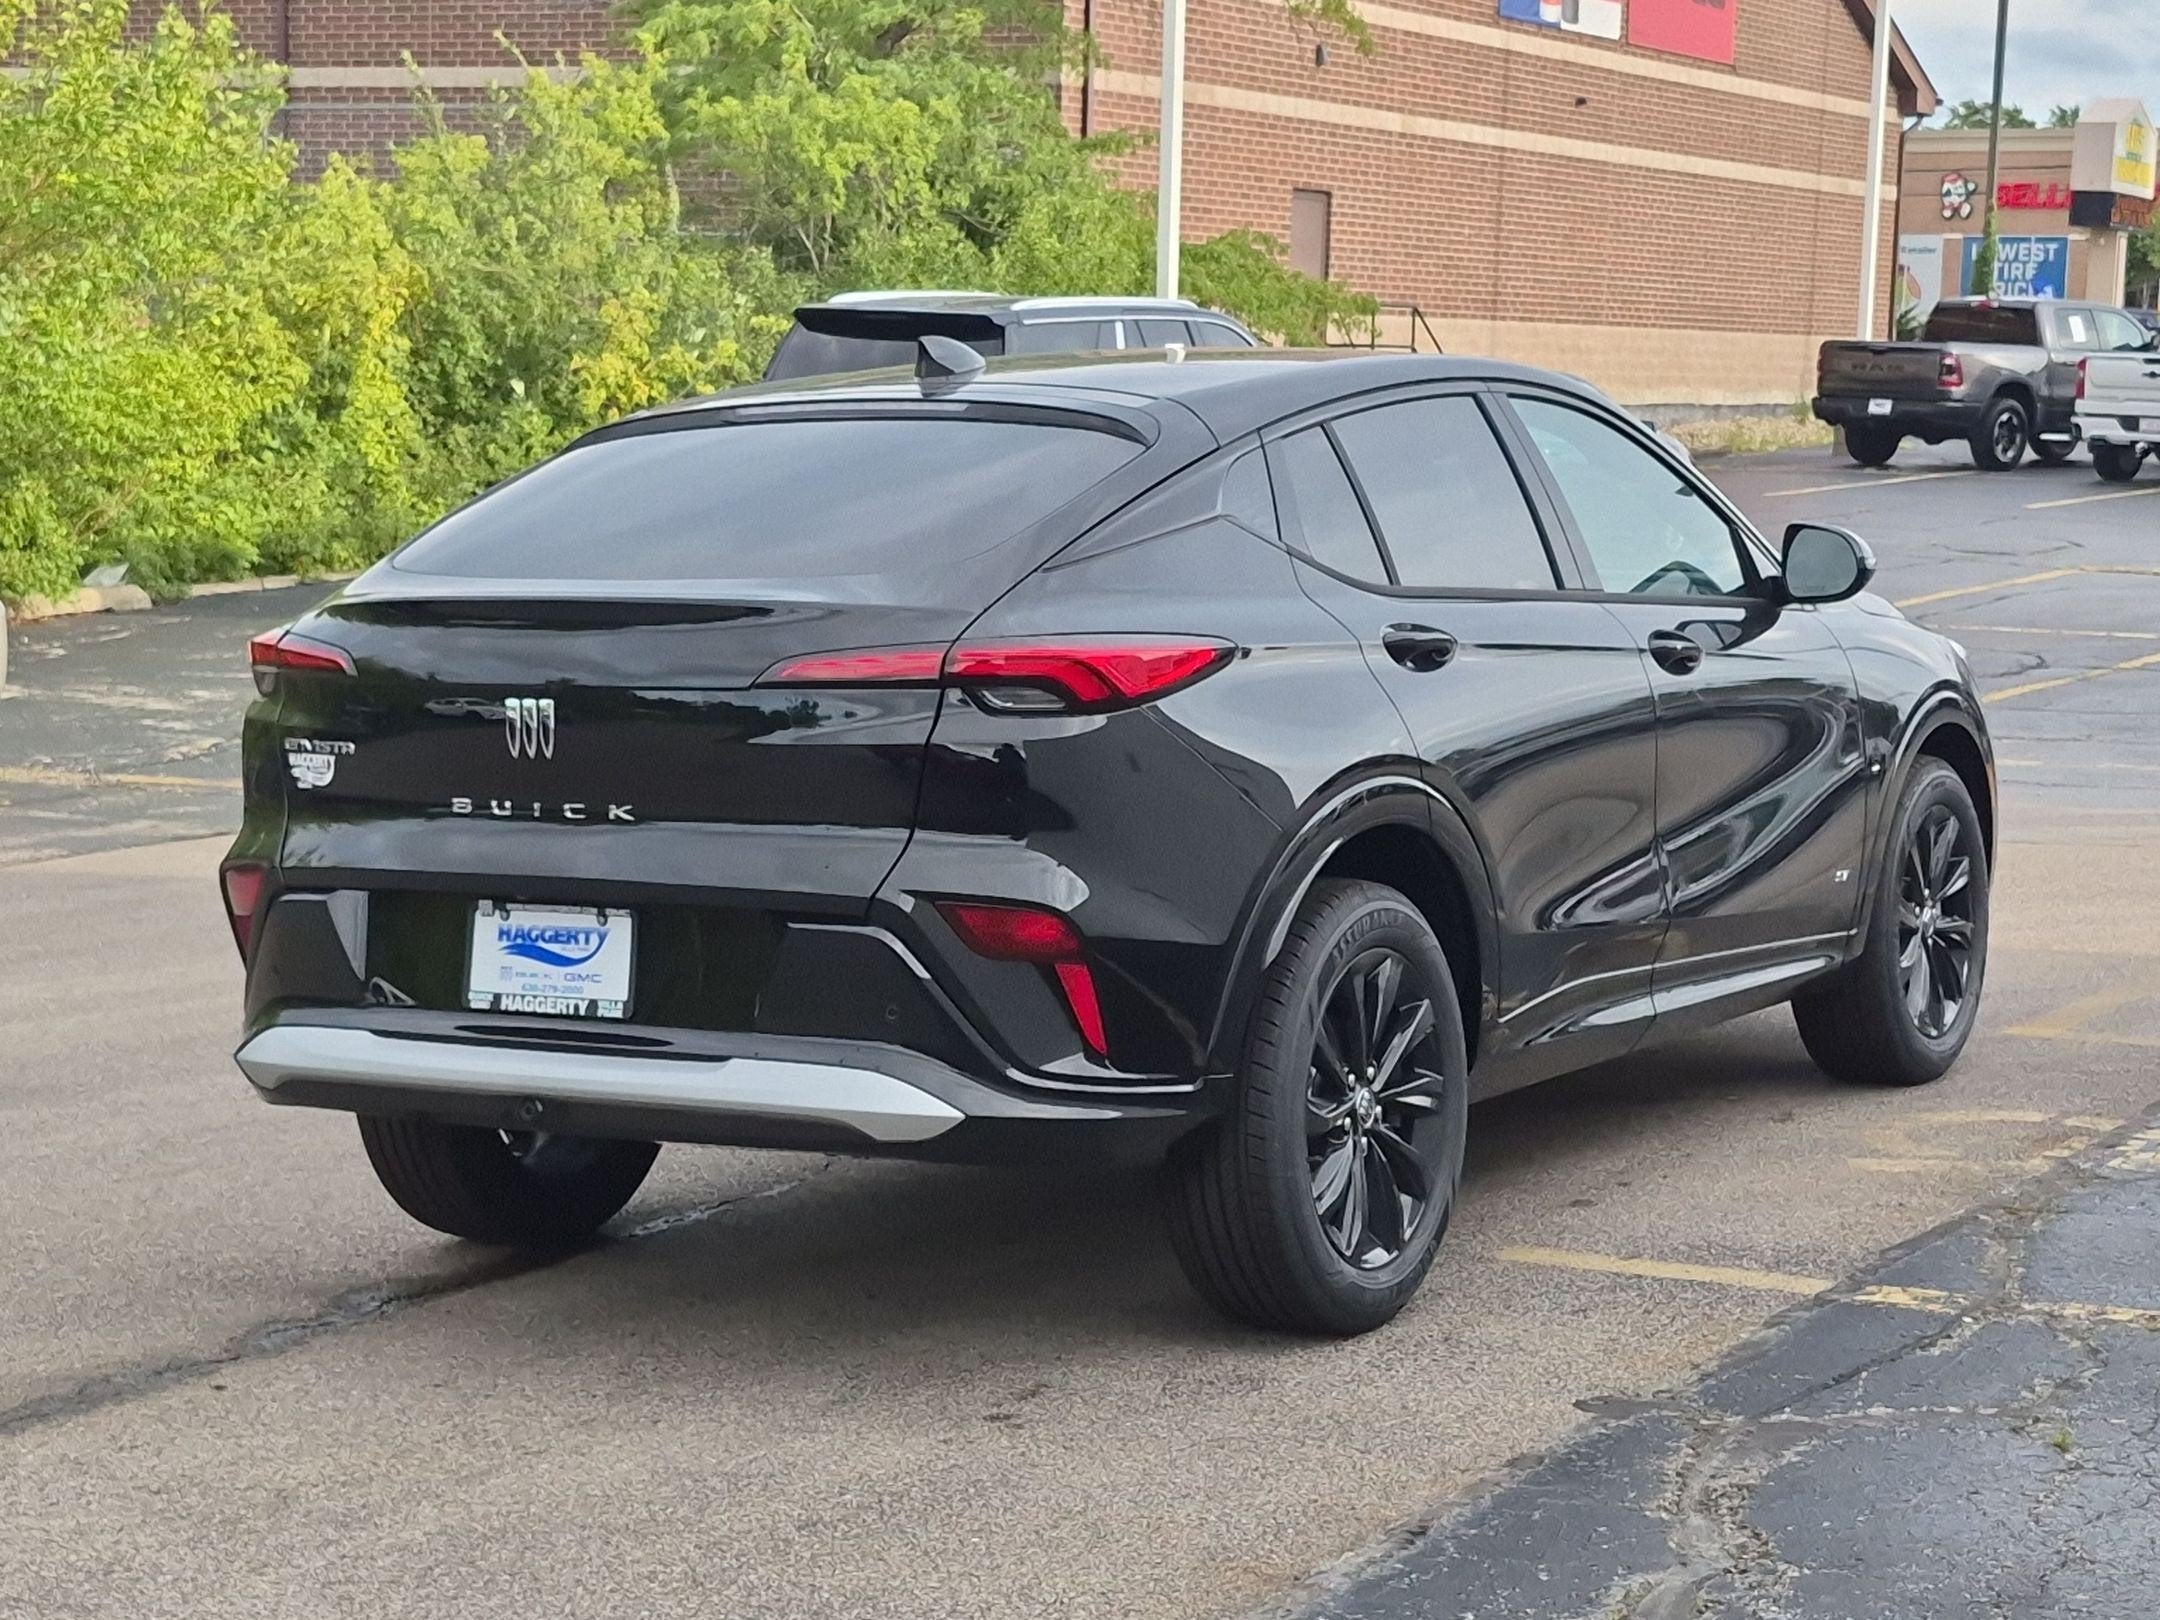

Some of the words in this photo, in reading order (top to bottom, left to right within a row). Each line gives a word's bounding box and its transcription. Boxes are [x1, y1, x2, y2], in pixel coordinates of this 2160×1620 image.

[1971, 242, 2060, 262] LWEST
[450, 797, 636, 822] BUICK
[497, 925, 611, 946] HAGGERTY
[564, 972, 603, 984] GMC
[500, 994, 590, 1016] HAGGERTY
